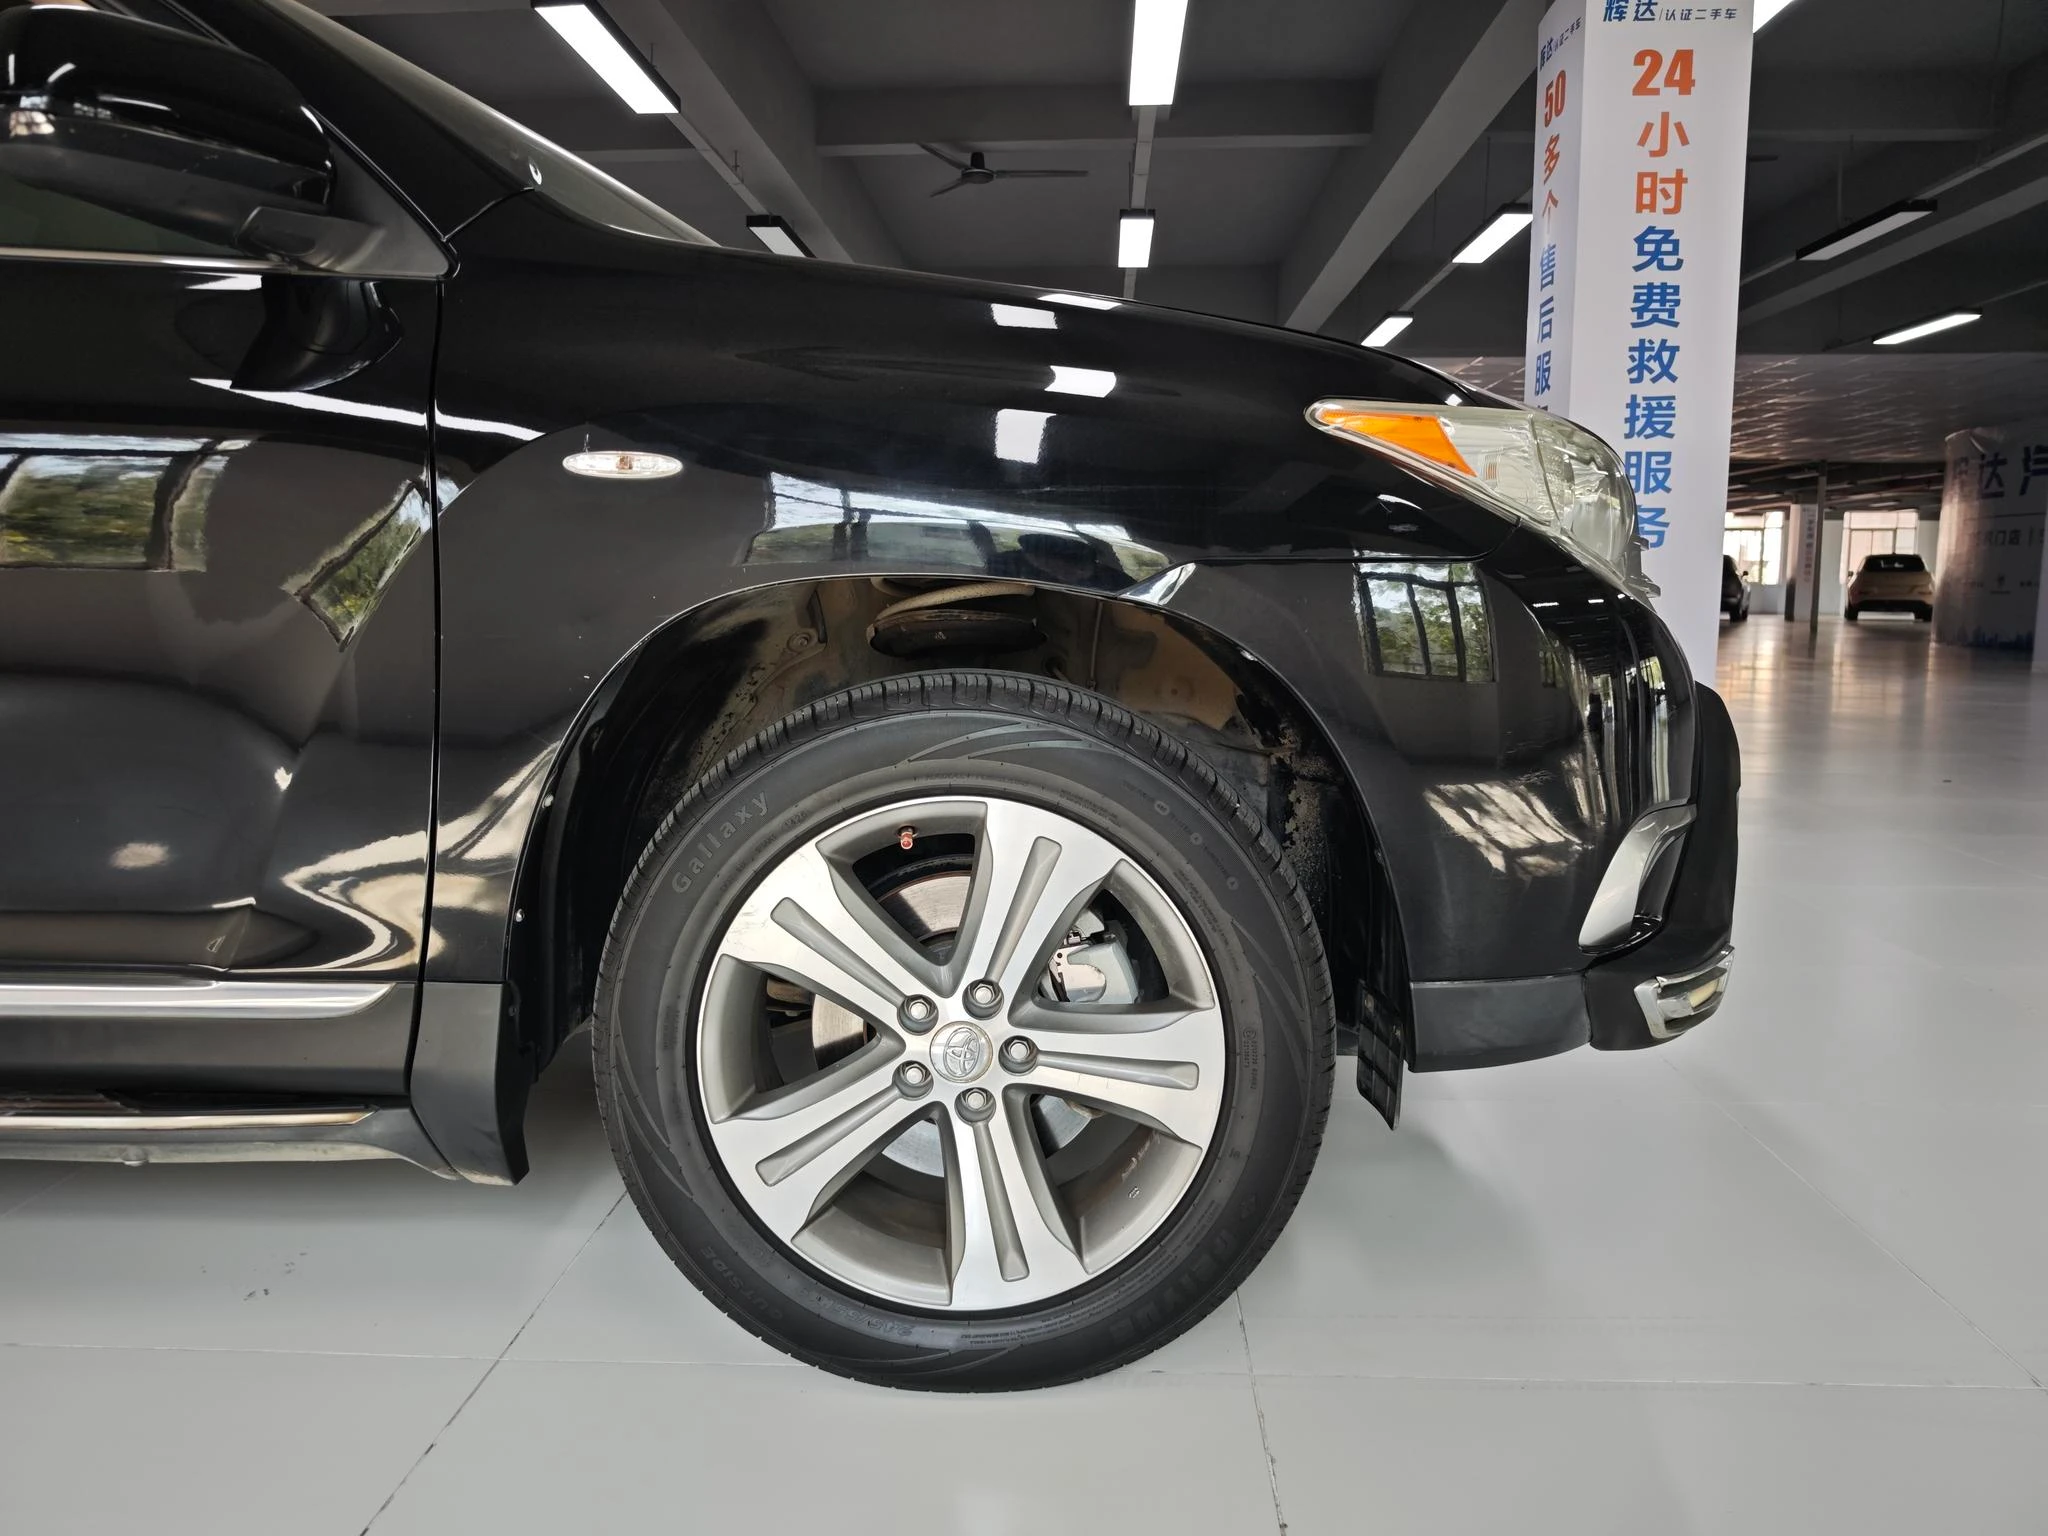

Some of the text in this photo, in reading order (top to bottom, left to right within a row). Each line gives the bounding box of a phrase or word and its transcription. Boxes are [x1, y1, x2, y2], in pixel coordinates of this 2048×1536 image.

[1535, 69, 1566, 411] 50多个售后服
[672, 791, 768, 893] Galaxy
